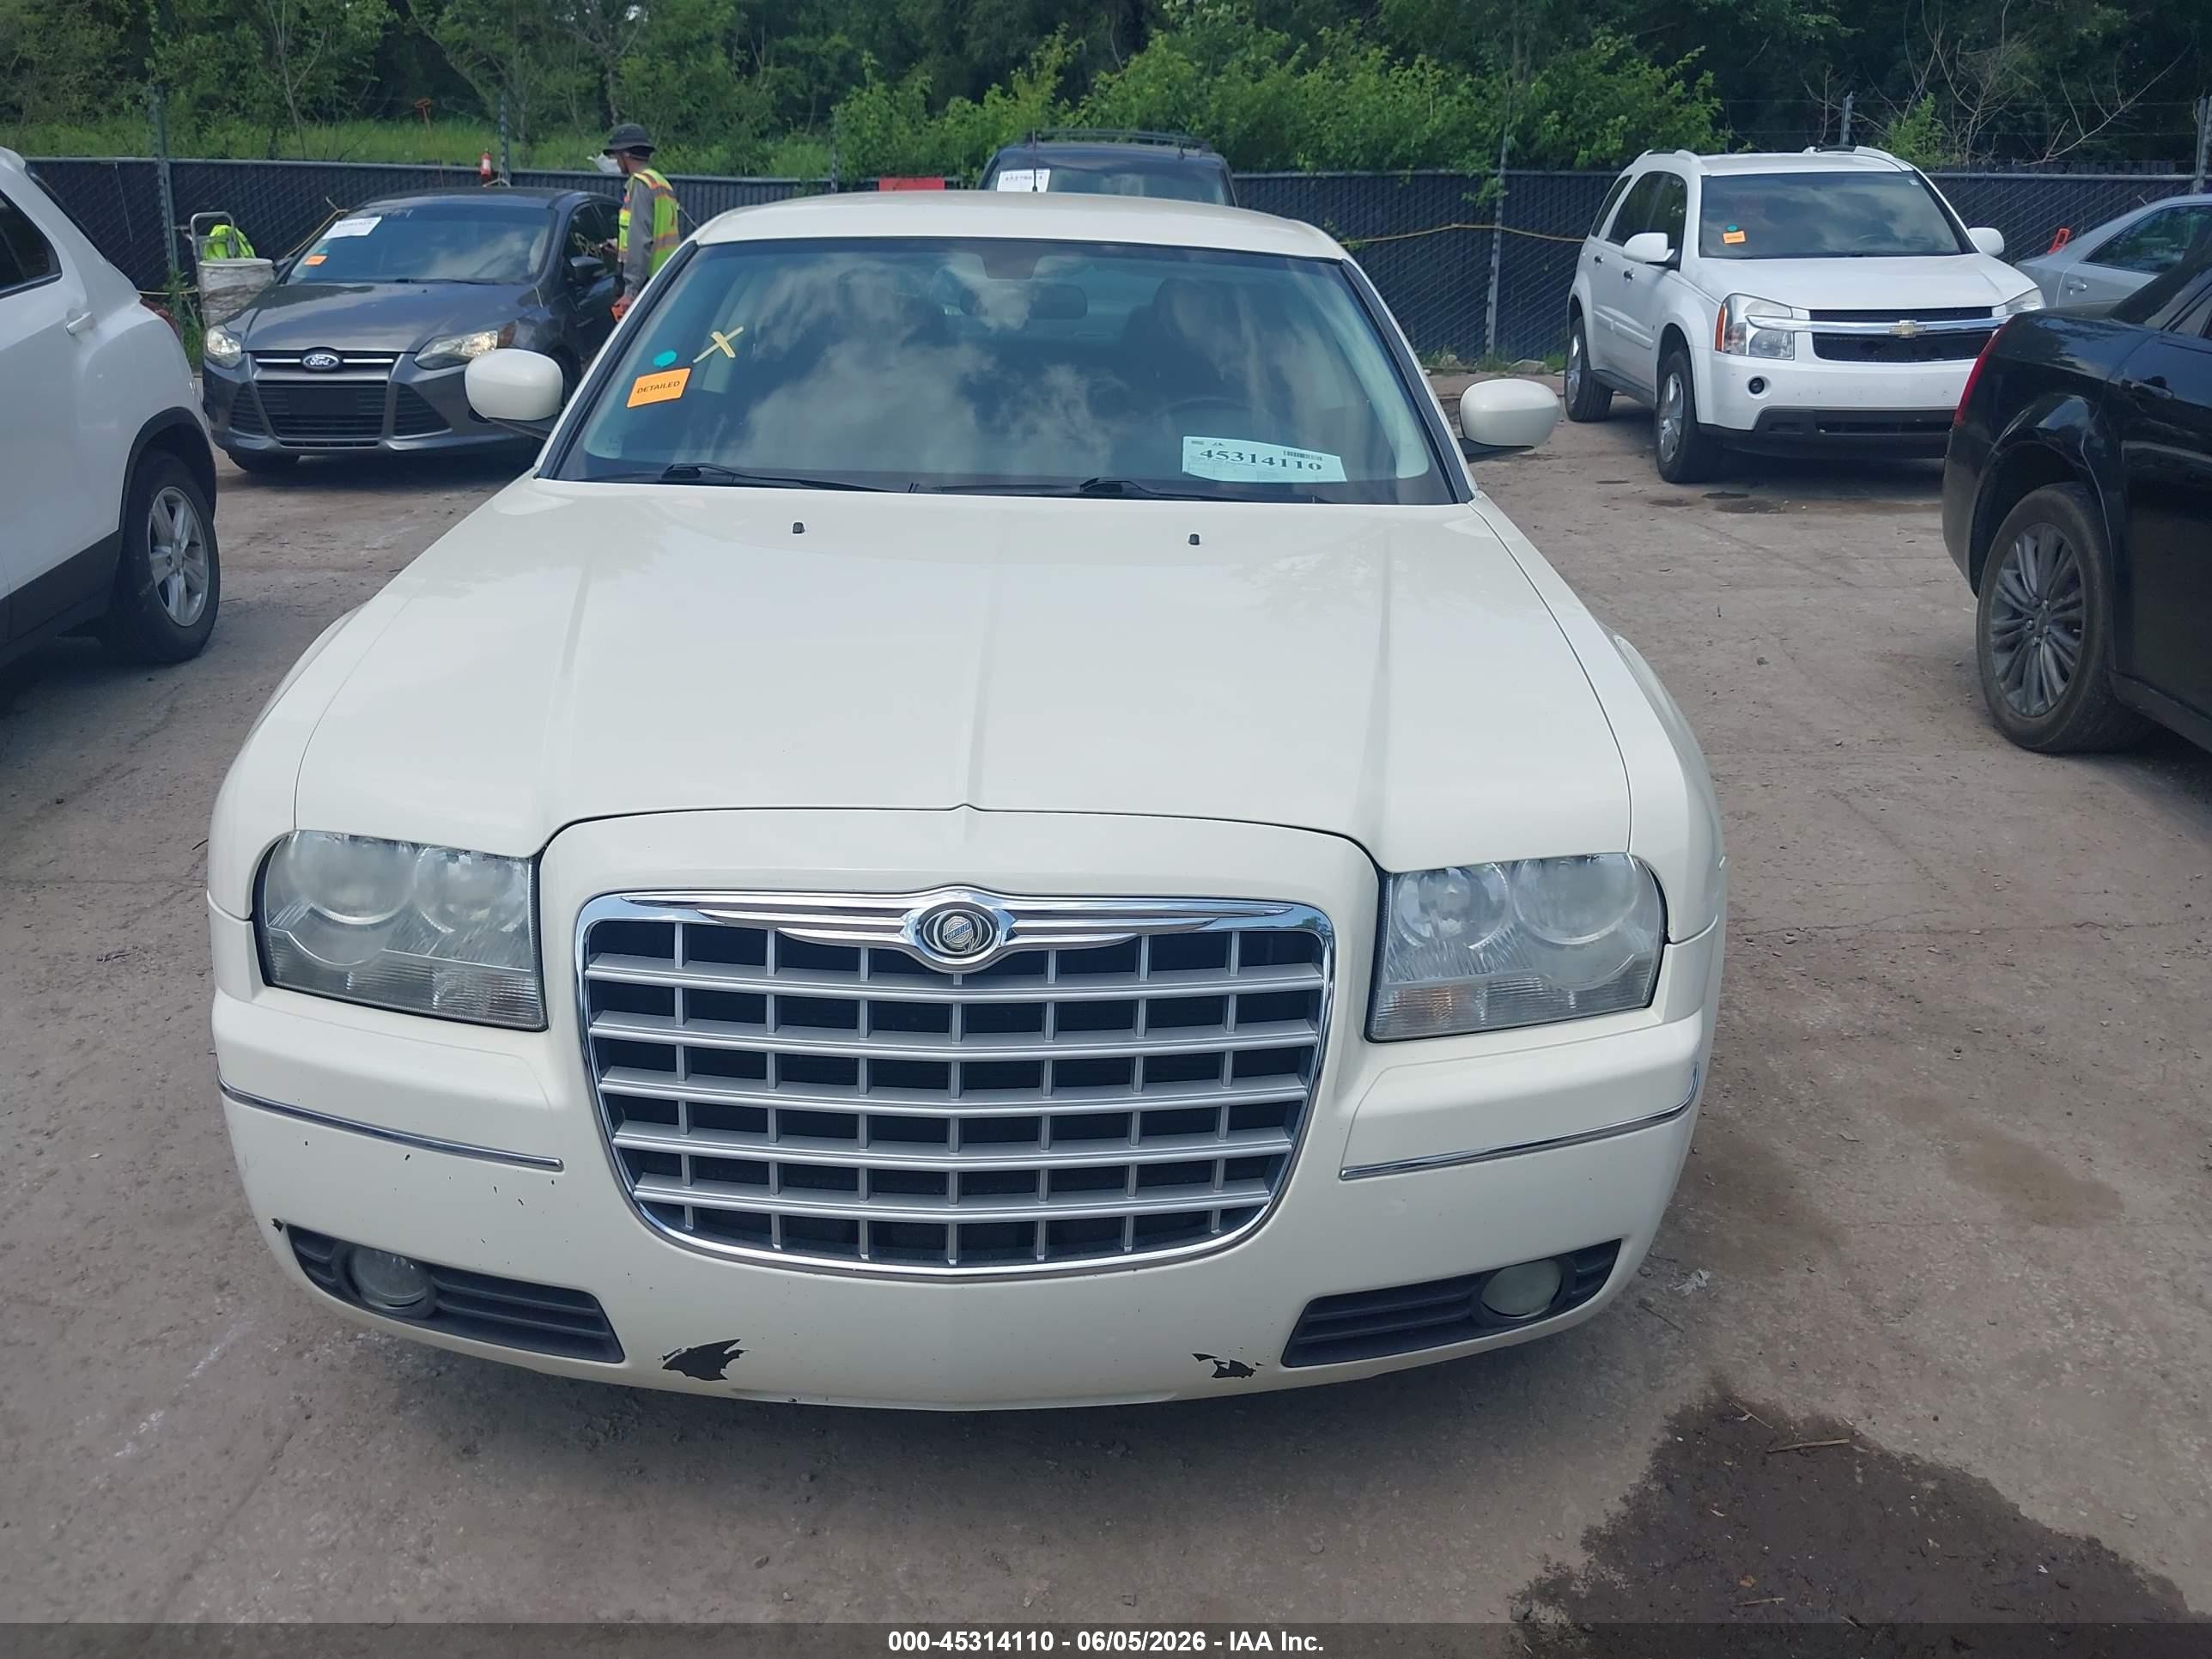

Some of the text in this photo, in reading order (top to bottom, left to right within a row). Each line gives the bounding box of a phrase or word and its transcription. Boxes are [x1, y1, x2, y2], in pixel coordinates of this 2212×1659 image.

[309, 356, 331, 366] Ford
[636, 380, 681, 394] DETAILED
[1200, 449, 1322, 471] 45314110
[945, 921, 971, 941] CHRYSLER
